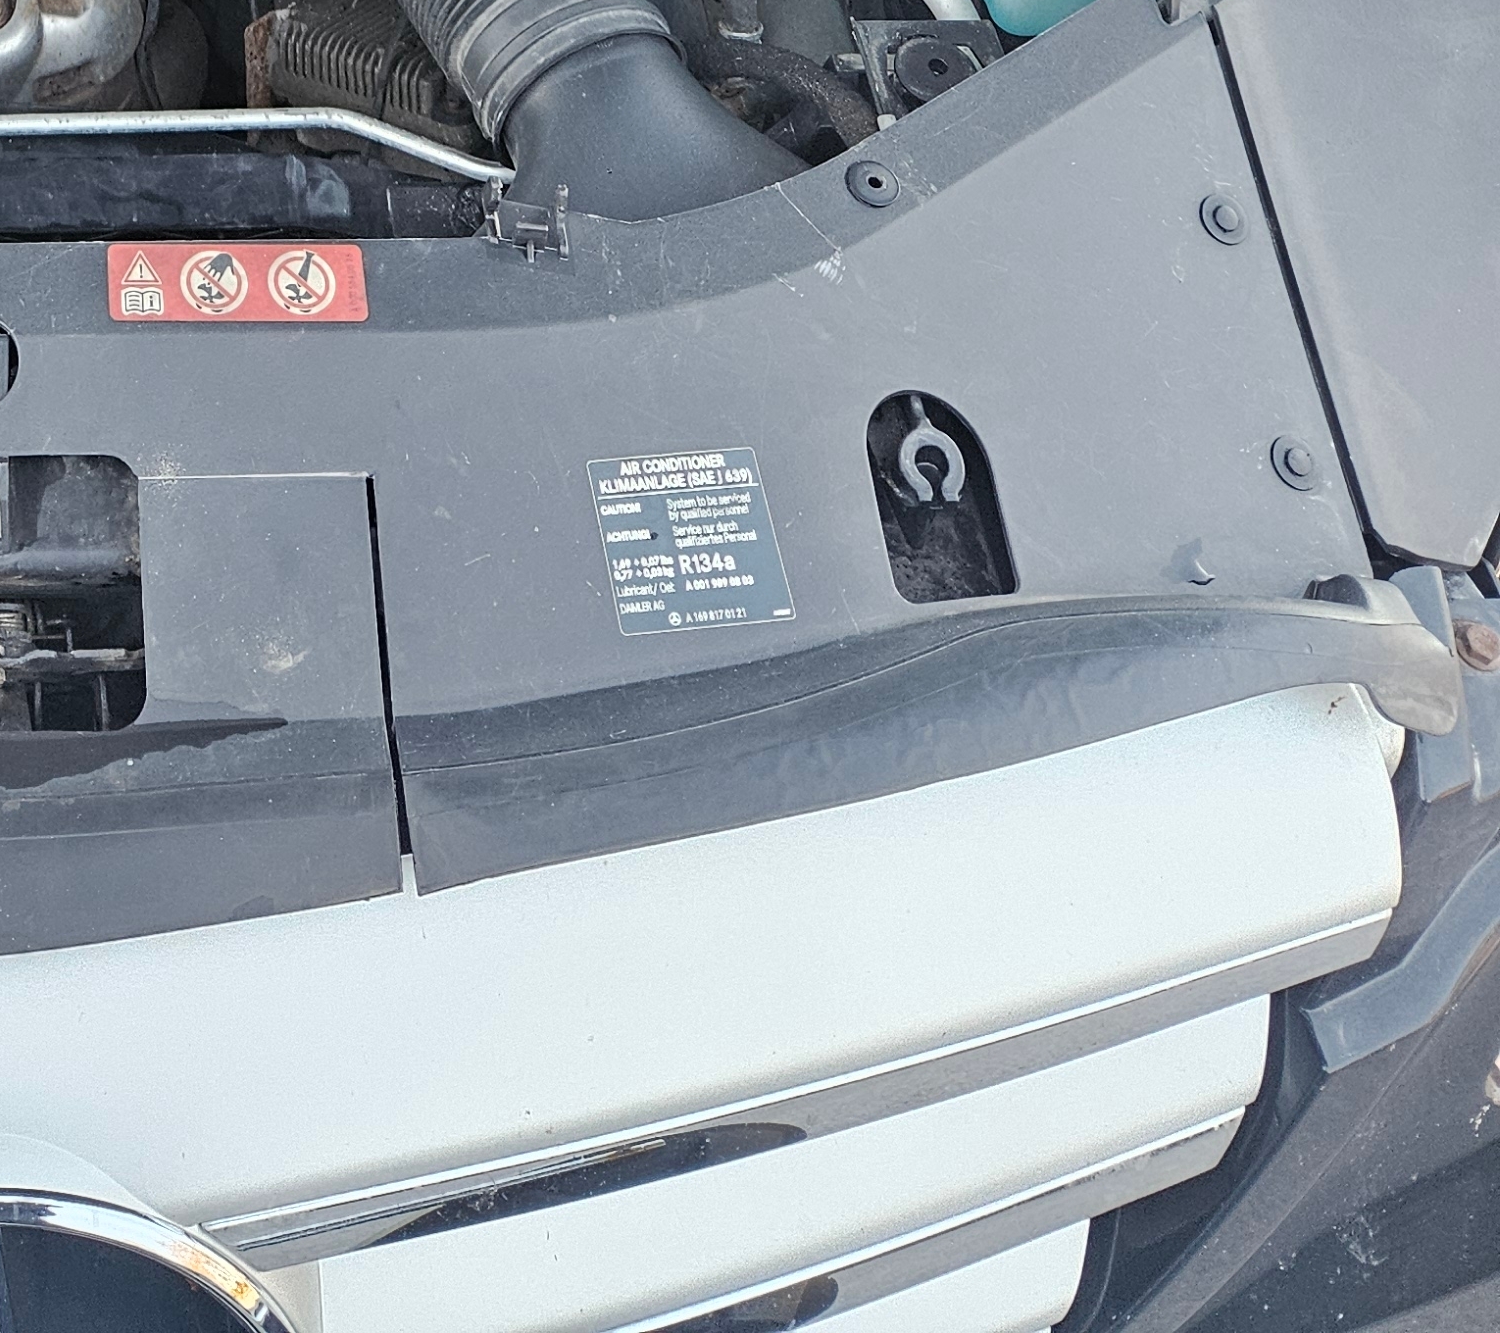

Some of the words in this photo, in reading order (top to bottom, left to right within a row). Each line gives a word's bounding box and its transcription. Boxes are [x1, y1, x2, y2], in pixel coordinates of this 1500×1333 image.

[619, 462, 640, 476] AIR
[642, 453, 725, 474] CONDITIONER
[599, 472, 685, 494] KLIMAANLAGE
[687, 469, 714, 487] (SAE
[725, 467, 752, 484] 639)
[600, 502, 641, 515] CAUTION!
[667, 496, 696, 511] System
[696, 495, 705, 506] to
[706, 494, 717, 505] be
[718, 491, 750, 504] serviced
[668, 510, 680, 522] by
[680, 507, 711, 521] qualified
[712, 503, 749, 518] personnel
[605, 529, 650, 542] ACHTUNG!
[672, 523, 702, 535] Service
[702, 524, 715, 533] nur
[716, 520, 738, 531] durch
[675, 533, 723, 548] qualifiziertes
[723, 529, 756, 542] Personal
[679, 550, 734, 574] R134a
[684, 580, 692, 590] A
[619, 602, 652, 613] DAIMLER
[652, 601, 664, 610] AG
[685, 612, 692, 622] A
[693, 611, 708, 621] 169
[724, 608, 735, 618] 01
[736, 607, 746, 617] 21
